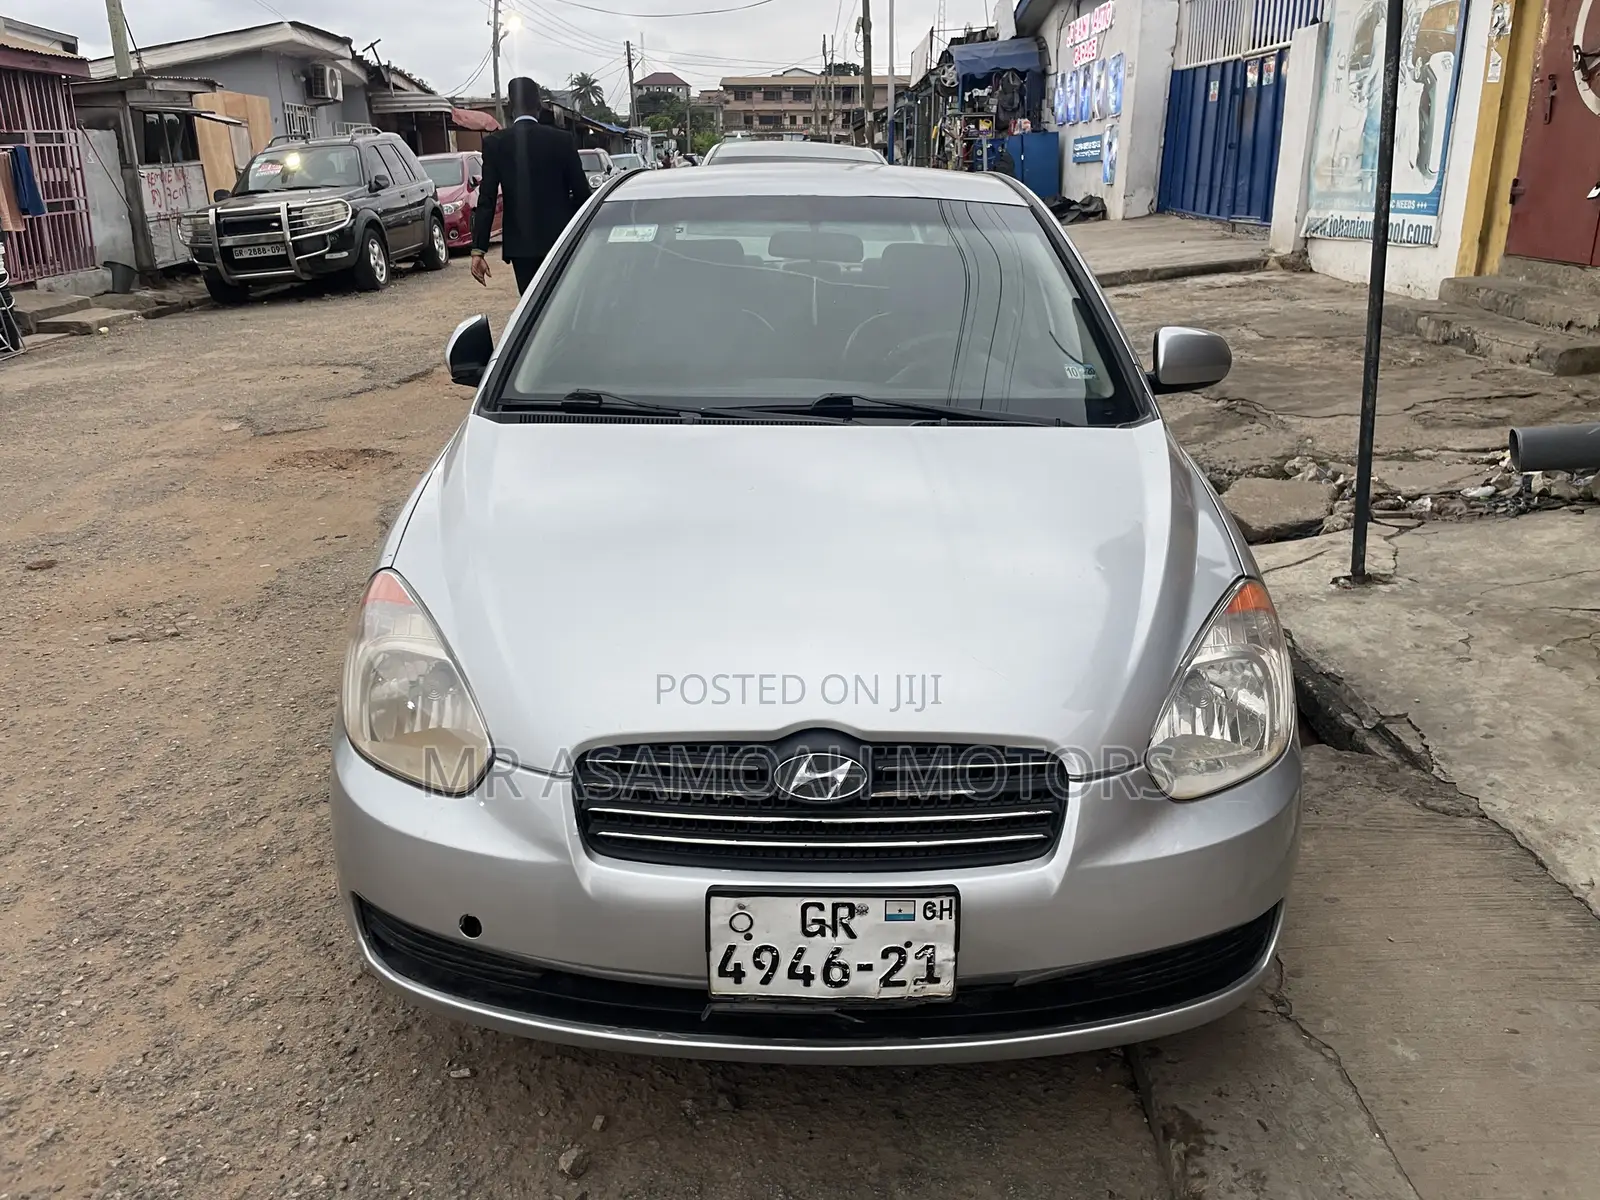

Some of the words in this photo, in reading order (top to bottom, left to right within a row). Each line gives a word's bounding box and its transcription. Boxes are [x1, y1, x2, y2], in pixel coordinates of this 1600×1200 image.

[1395, 200, 1416, 210] NEEDS
[235, 249, 244, 257] GR
[801, 902, 857, 940] GR
[923, 899, 953, 921] GH
[718, 944, 942, 989] 4946-21
